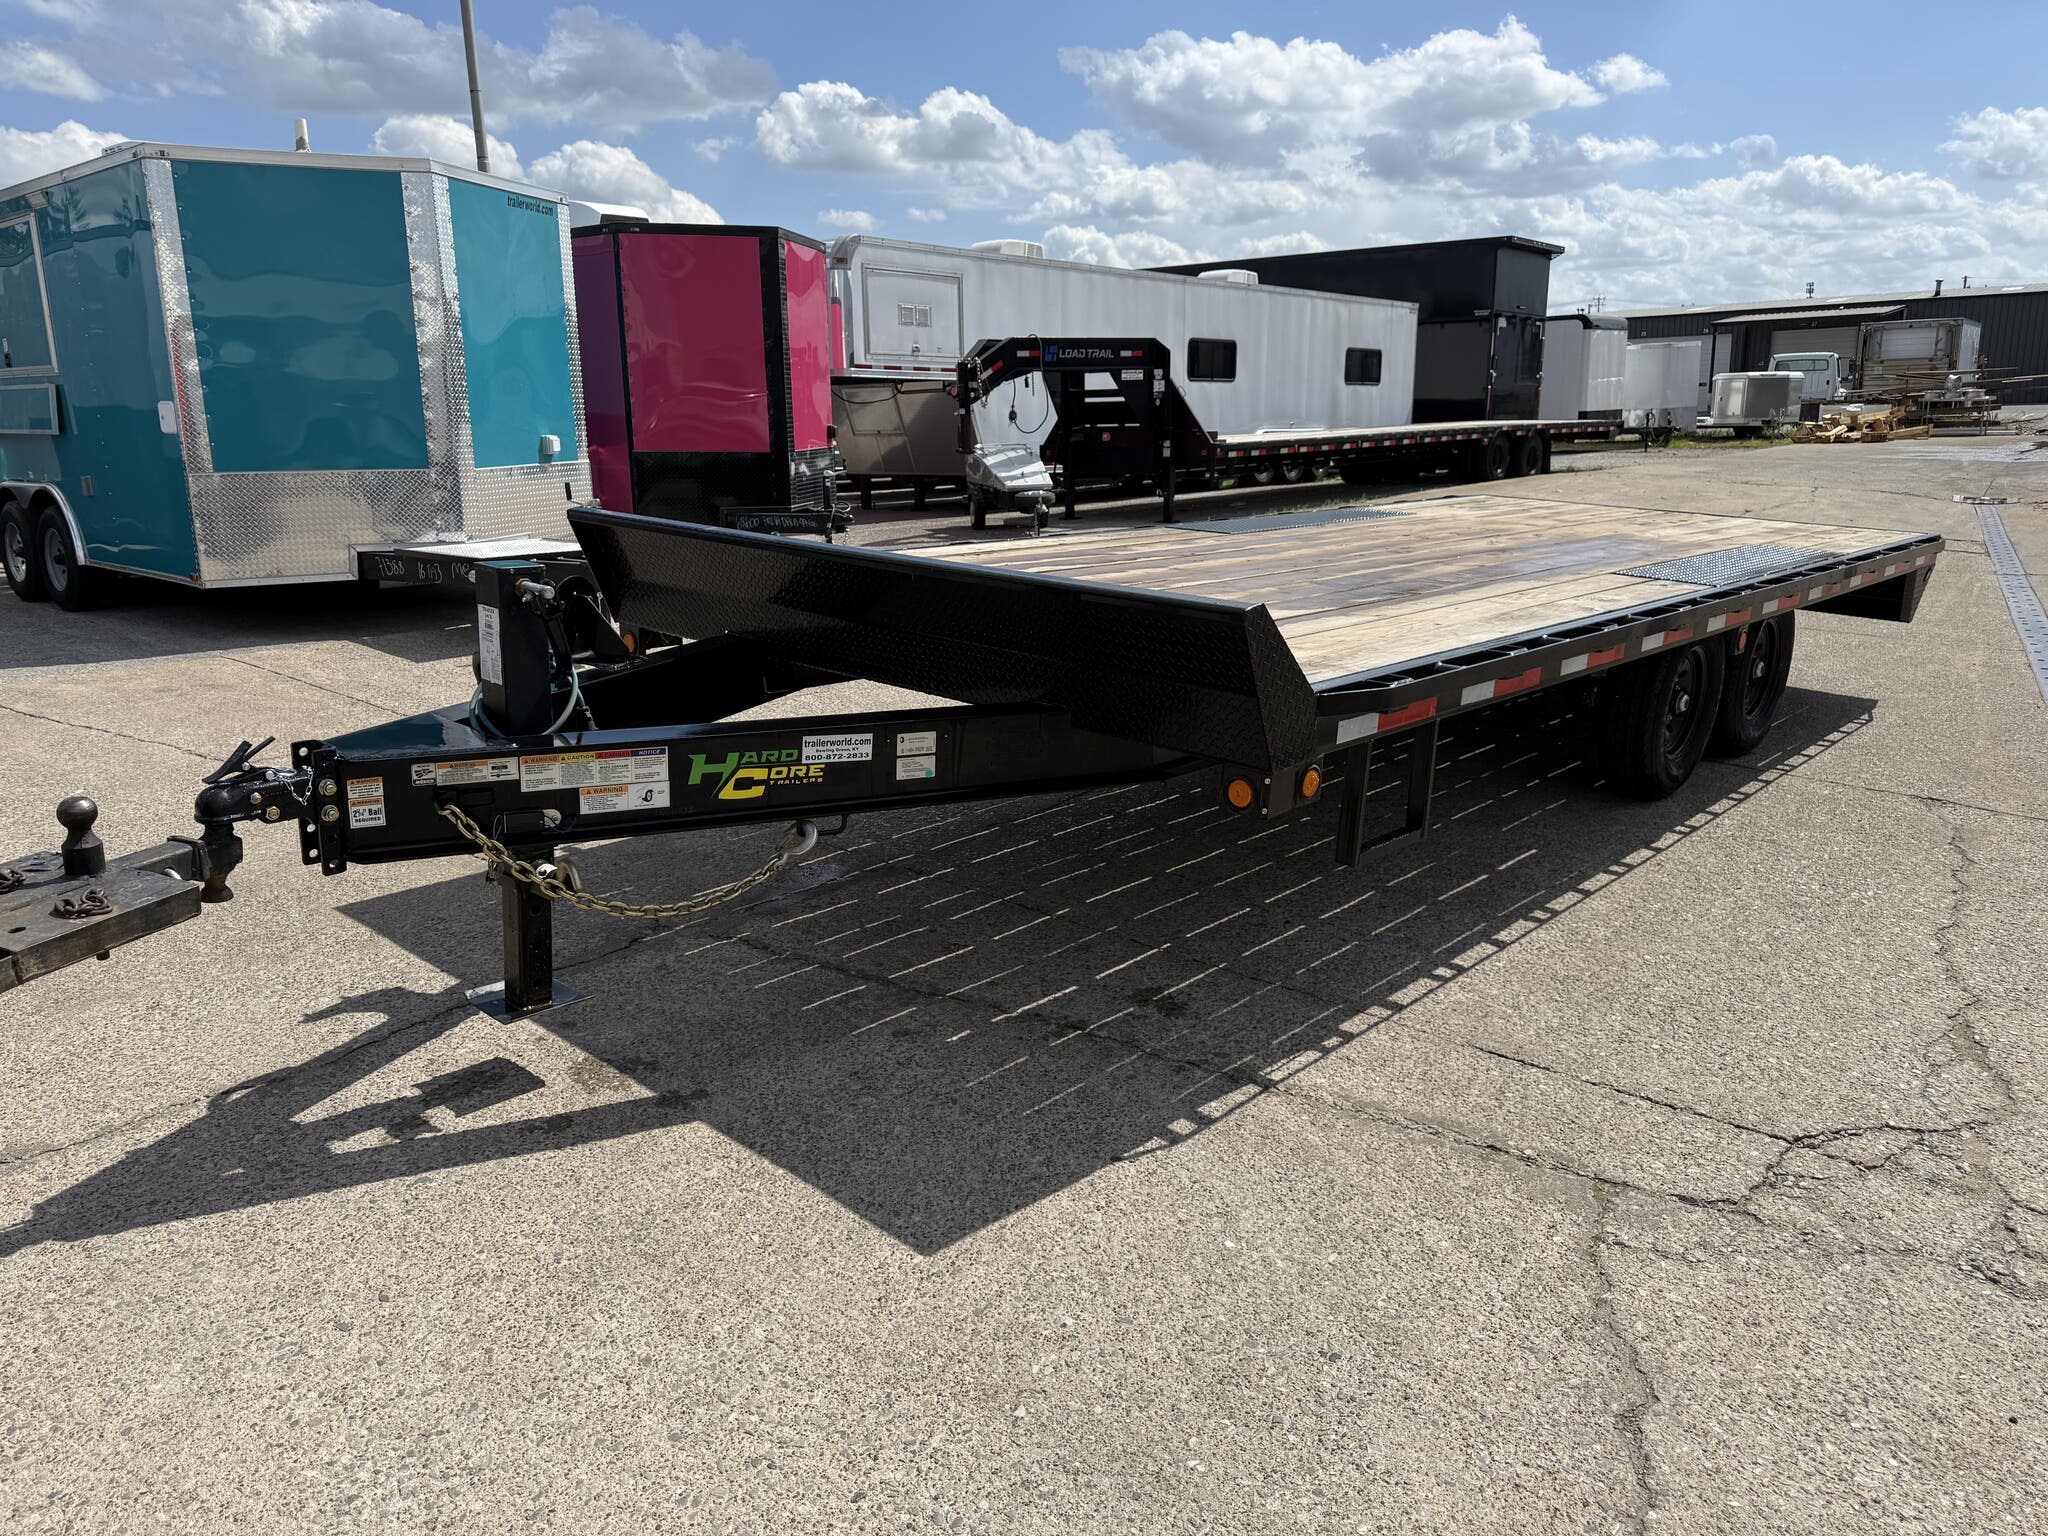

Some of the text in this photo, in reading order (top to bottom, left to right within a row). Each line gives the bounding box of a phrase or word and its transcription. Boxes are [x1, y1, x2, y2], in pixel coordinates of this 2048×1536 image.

[507, 195, 553, 216] trailerworld.com
[1059, 349, 1114, 358] LOAD TRAIL
[804, 737, 872, 748] trailerworld.com
[805, 752, 870, 761] 800-872-2833
[688, 749, 798, 797] HARD
[718, 764, 826, 800] CORE
[769, 777, 823, 785] TRAILERS
[593, 785, 623, 794] WARNING
[368, 807, 382, 816] Ball
